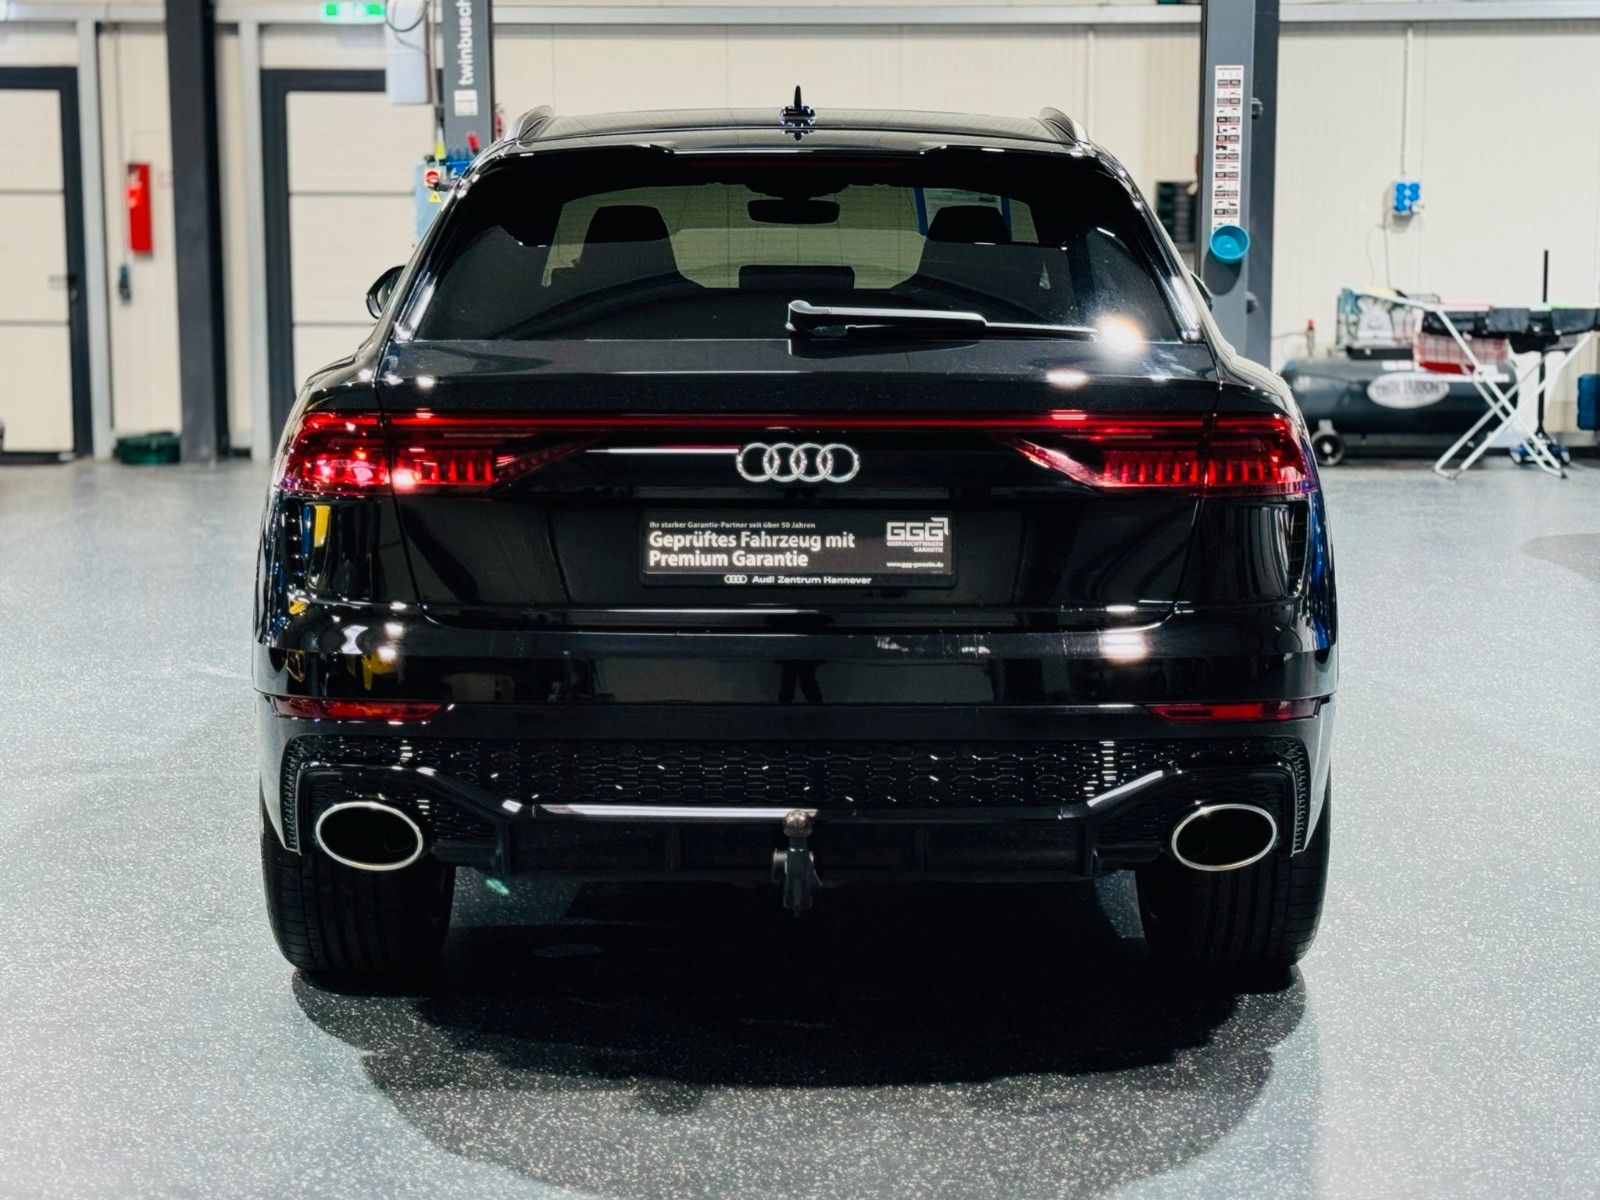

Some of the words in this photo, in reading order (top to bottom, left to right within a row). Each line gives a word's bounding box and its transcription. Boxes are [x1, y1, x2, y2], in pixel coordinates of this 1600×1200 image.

[661, 521, 686, 529] starker
[763, 521, 780, 529] über
[791, 521, 816, 529] Jahren
[886, 521, 944, 541] GGG
[649, 531, 737, 551] Geprüftes
[740, 530, 822, 552] Fahrzeug
[825, 531, 856, 548] mit
[649, 550, 729, 567] Premium
[732, 549, 809, 567] Garantie
[752, 575, 775, 584] Audi
[777, 575, 822, 584] Zentrum
[823, 575, 872, 584] Hannover
